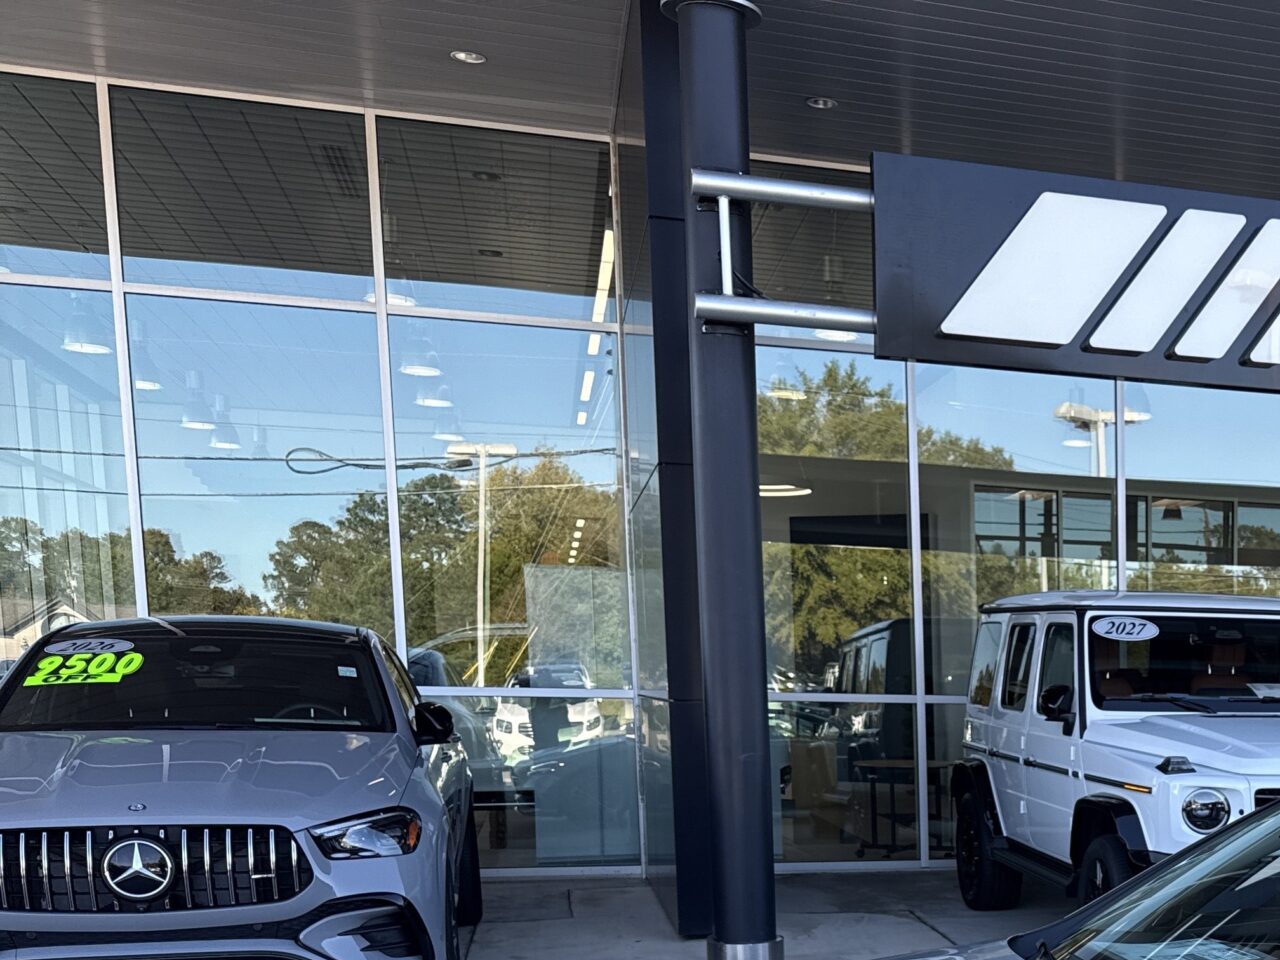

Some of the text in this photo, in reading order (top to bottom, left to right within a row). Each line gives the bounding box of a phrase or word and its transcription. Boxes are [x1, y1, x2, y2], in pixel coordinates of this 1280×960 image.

[1104, 621, 1147, 635] 2027
[57, 642, 116, 652] 2026
[35, 652, 143, 676] 9500
[41, 674, 103, 683] OFF
